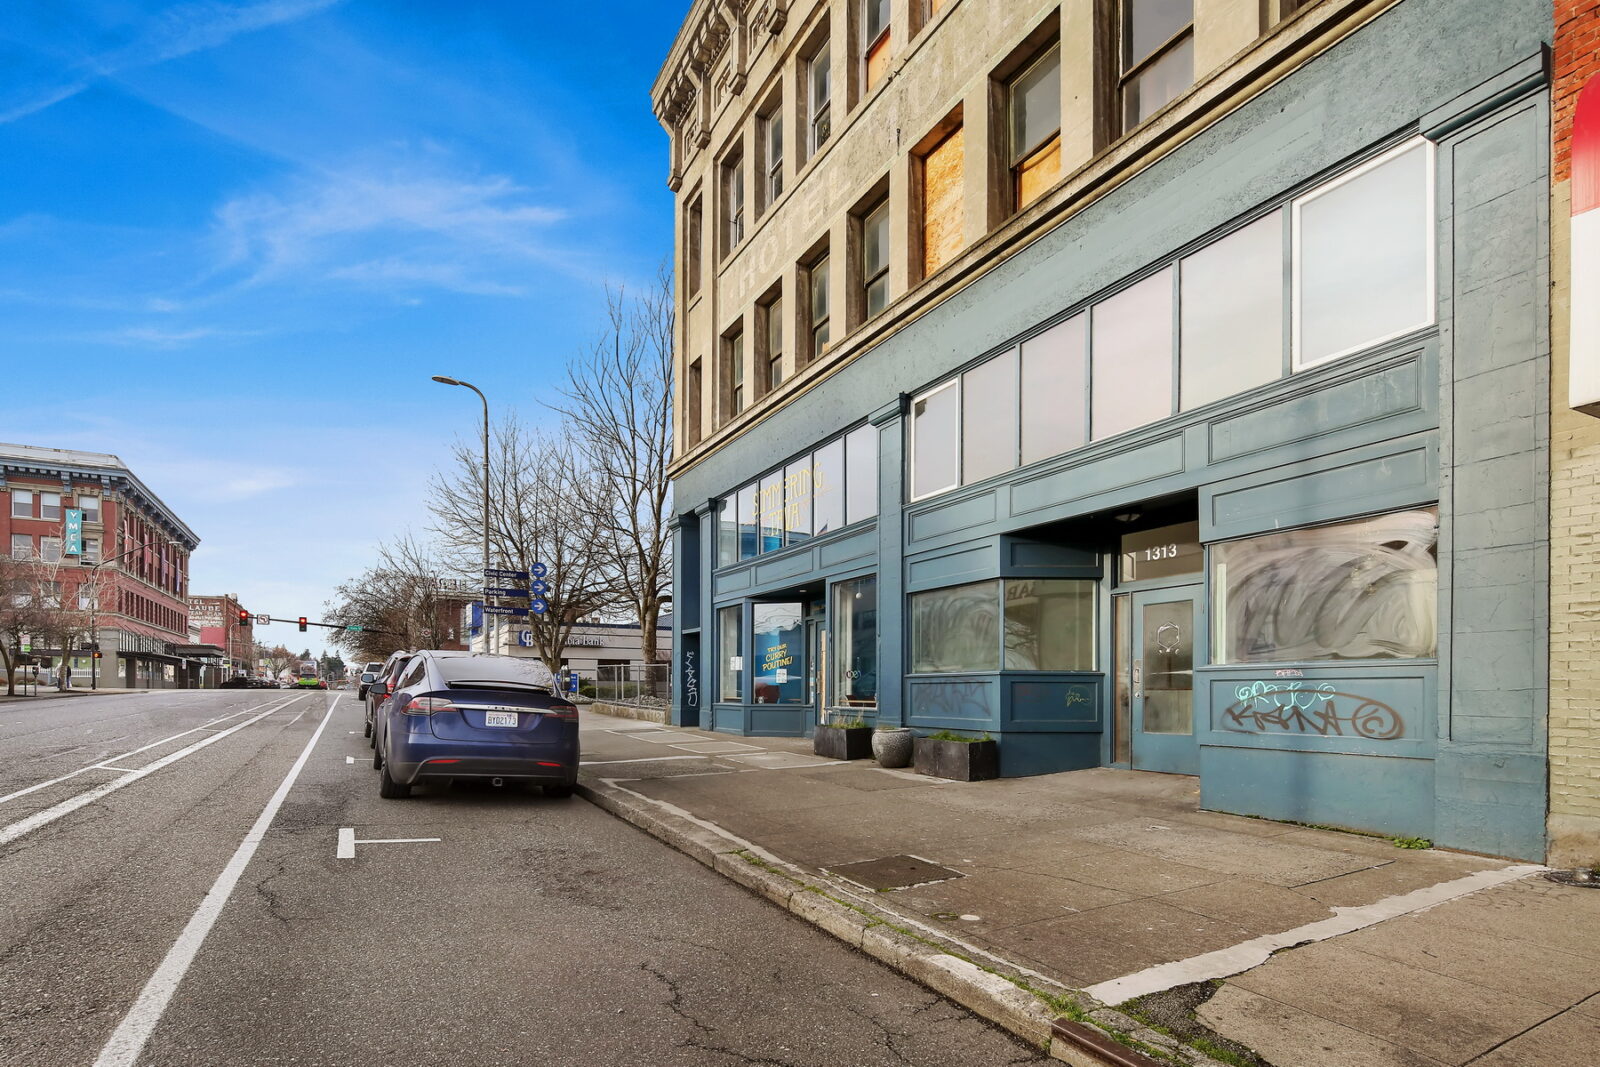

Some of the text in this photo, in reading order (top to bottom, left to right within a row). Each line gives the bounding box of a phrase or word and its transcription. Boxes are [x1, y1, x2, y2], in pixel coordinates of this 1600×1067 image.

[751, 462, 823, 517] SIMMERING
[68, 511, 78, 552] YMCA
[1144, 543, 1177, 562] 1313
[485, 588, 506, 596] Parking
[762, 655, 793, 671] POUTINE!
[765, 649, 787, 662] CURRY
